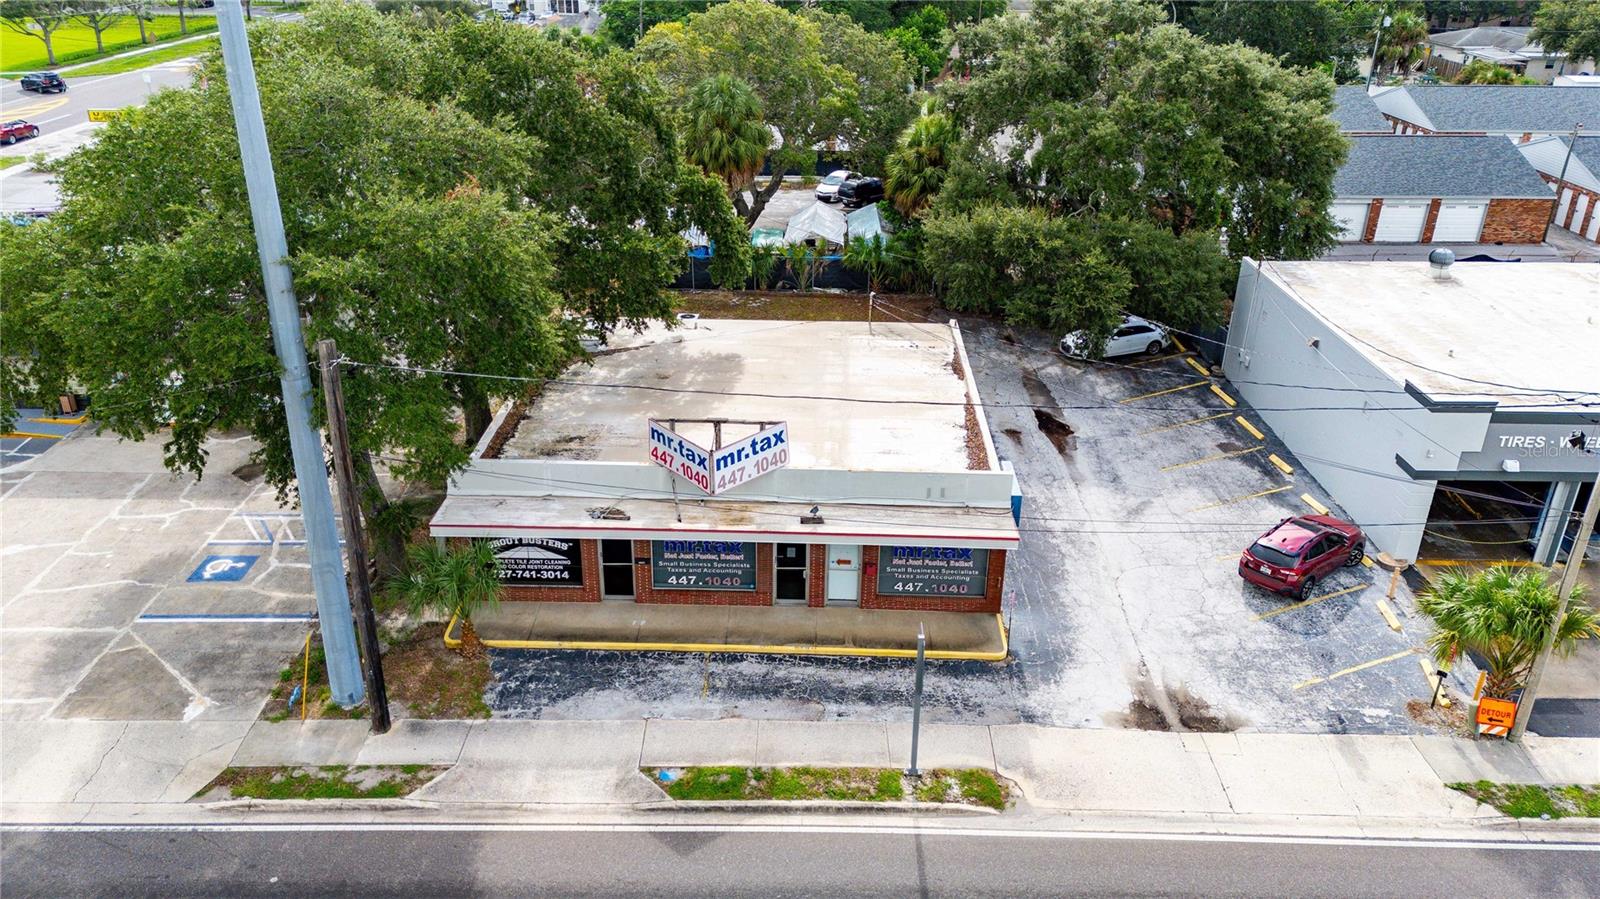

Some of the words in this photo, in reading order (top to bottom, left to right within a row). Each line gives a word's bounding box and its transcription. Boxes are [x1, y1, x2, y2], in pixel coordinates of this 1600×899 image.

[1499, 435, 1546, 448] TIRES
[650, 427, 708, 471] mr.tax
[715, 429, 786, 471] mr.tax
[930, 574, 970, 582] Accounting
[1481, 708, 1512, 719] DETOUR
